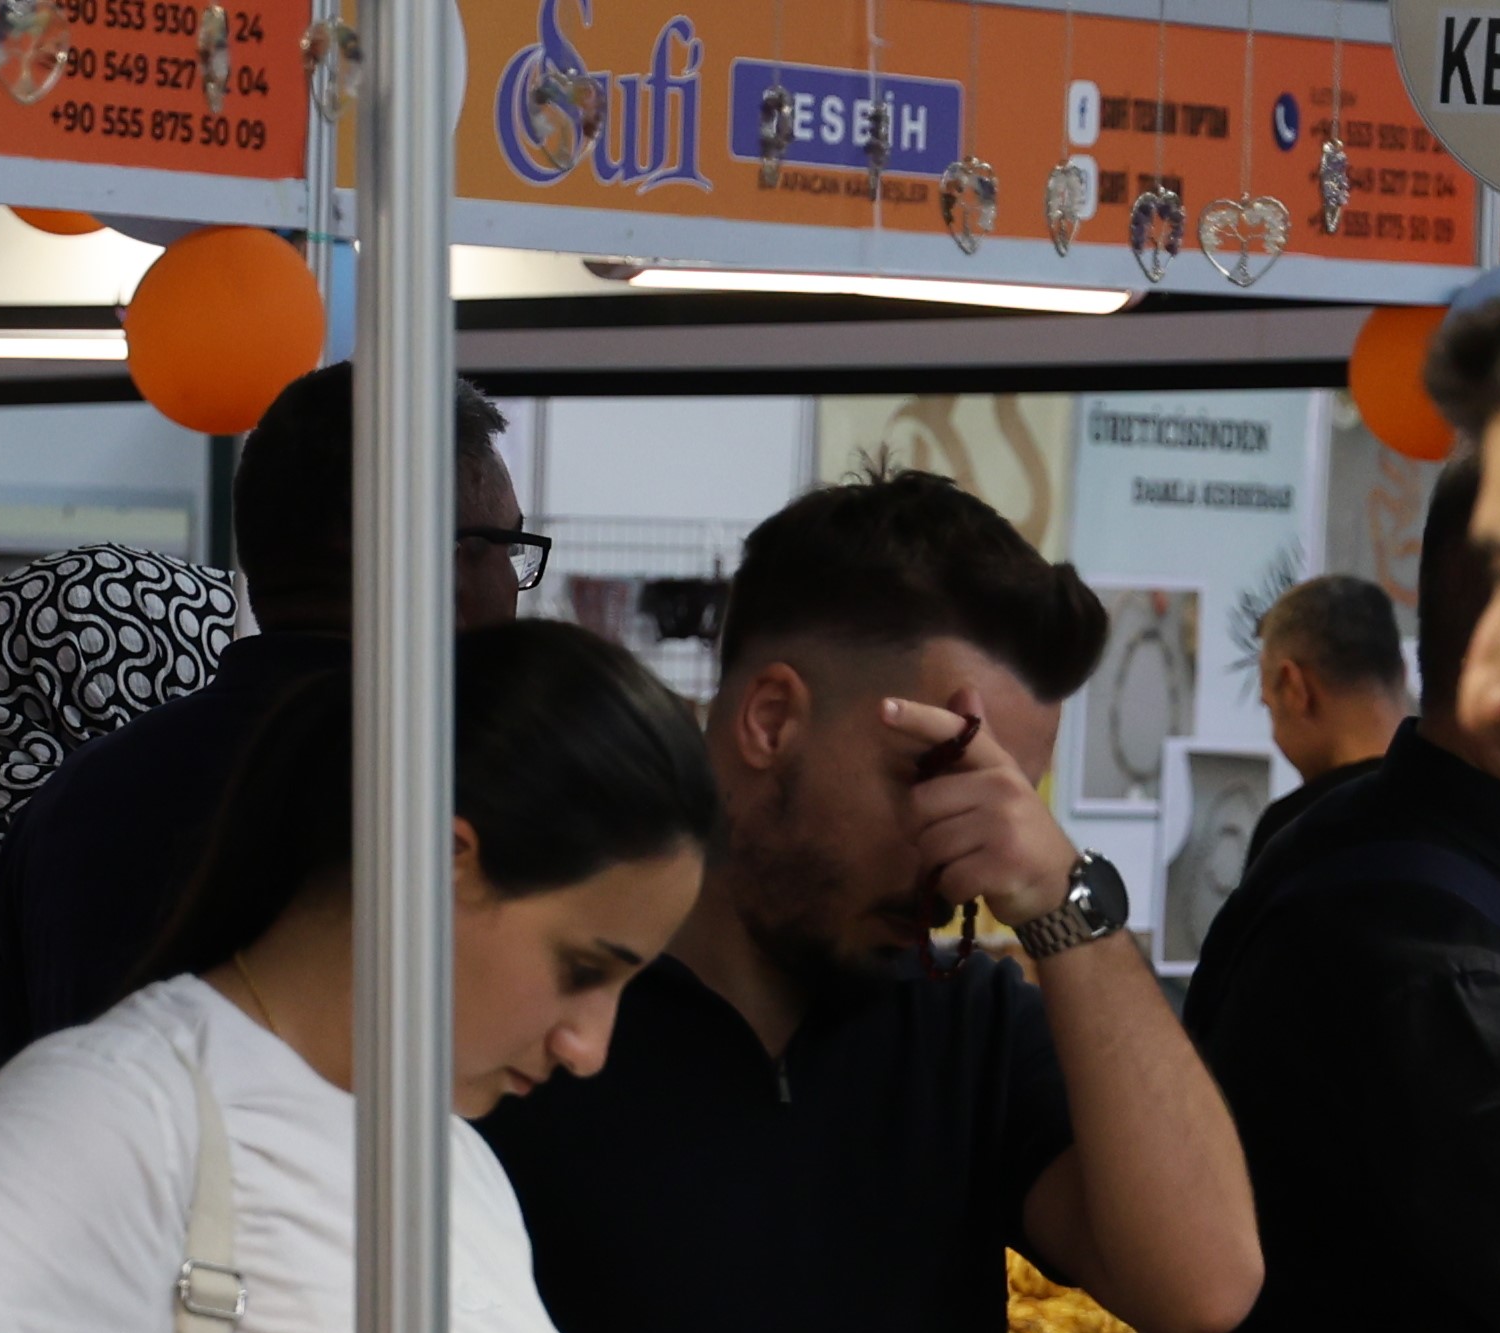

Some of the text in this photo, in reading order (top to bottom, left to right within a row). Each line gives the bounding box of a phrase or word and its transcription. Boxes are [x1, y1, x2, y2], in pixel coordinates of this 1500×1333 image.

[104, 0, 147, 31] 553
[153, 3, 198, 36] 930
[235, 12, 265, 43] 24
[104, 49, 148, 85] 549
[155, 56, 199, 90] 527
[237, 65, 270, 97] 04
[51, 100, 266, 151] +90 555 875 50 09
[763, 88, 928, 152] ESBİH
